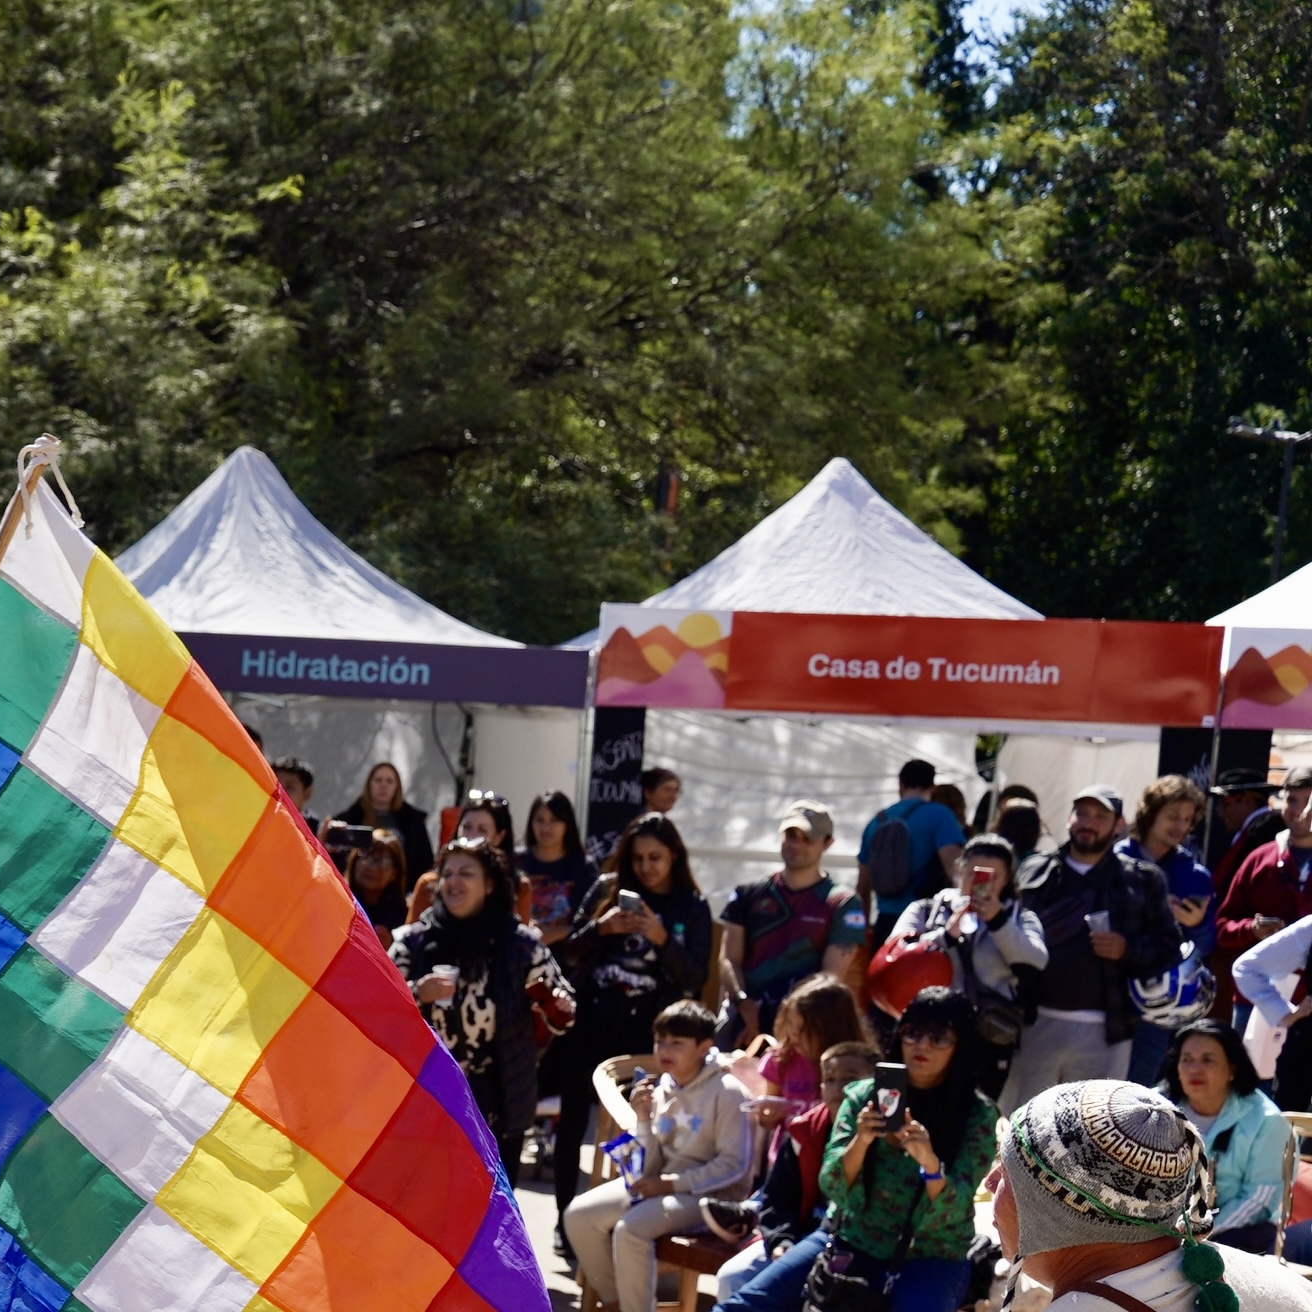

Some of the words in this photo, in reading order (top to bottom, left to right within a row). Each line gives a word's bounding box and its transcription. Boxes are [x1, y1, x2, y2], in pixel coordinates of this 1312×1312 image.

[241, 650, 430, 685] Hidratación
[808, 653, 879, 679] Casa
[885, 656, 921, 680] de
[927, 657, 1060, 685] Tucumán
